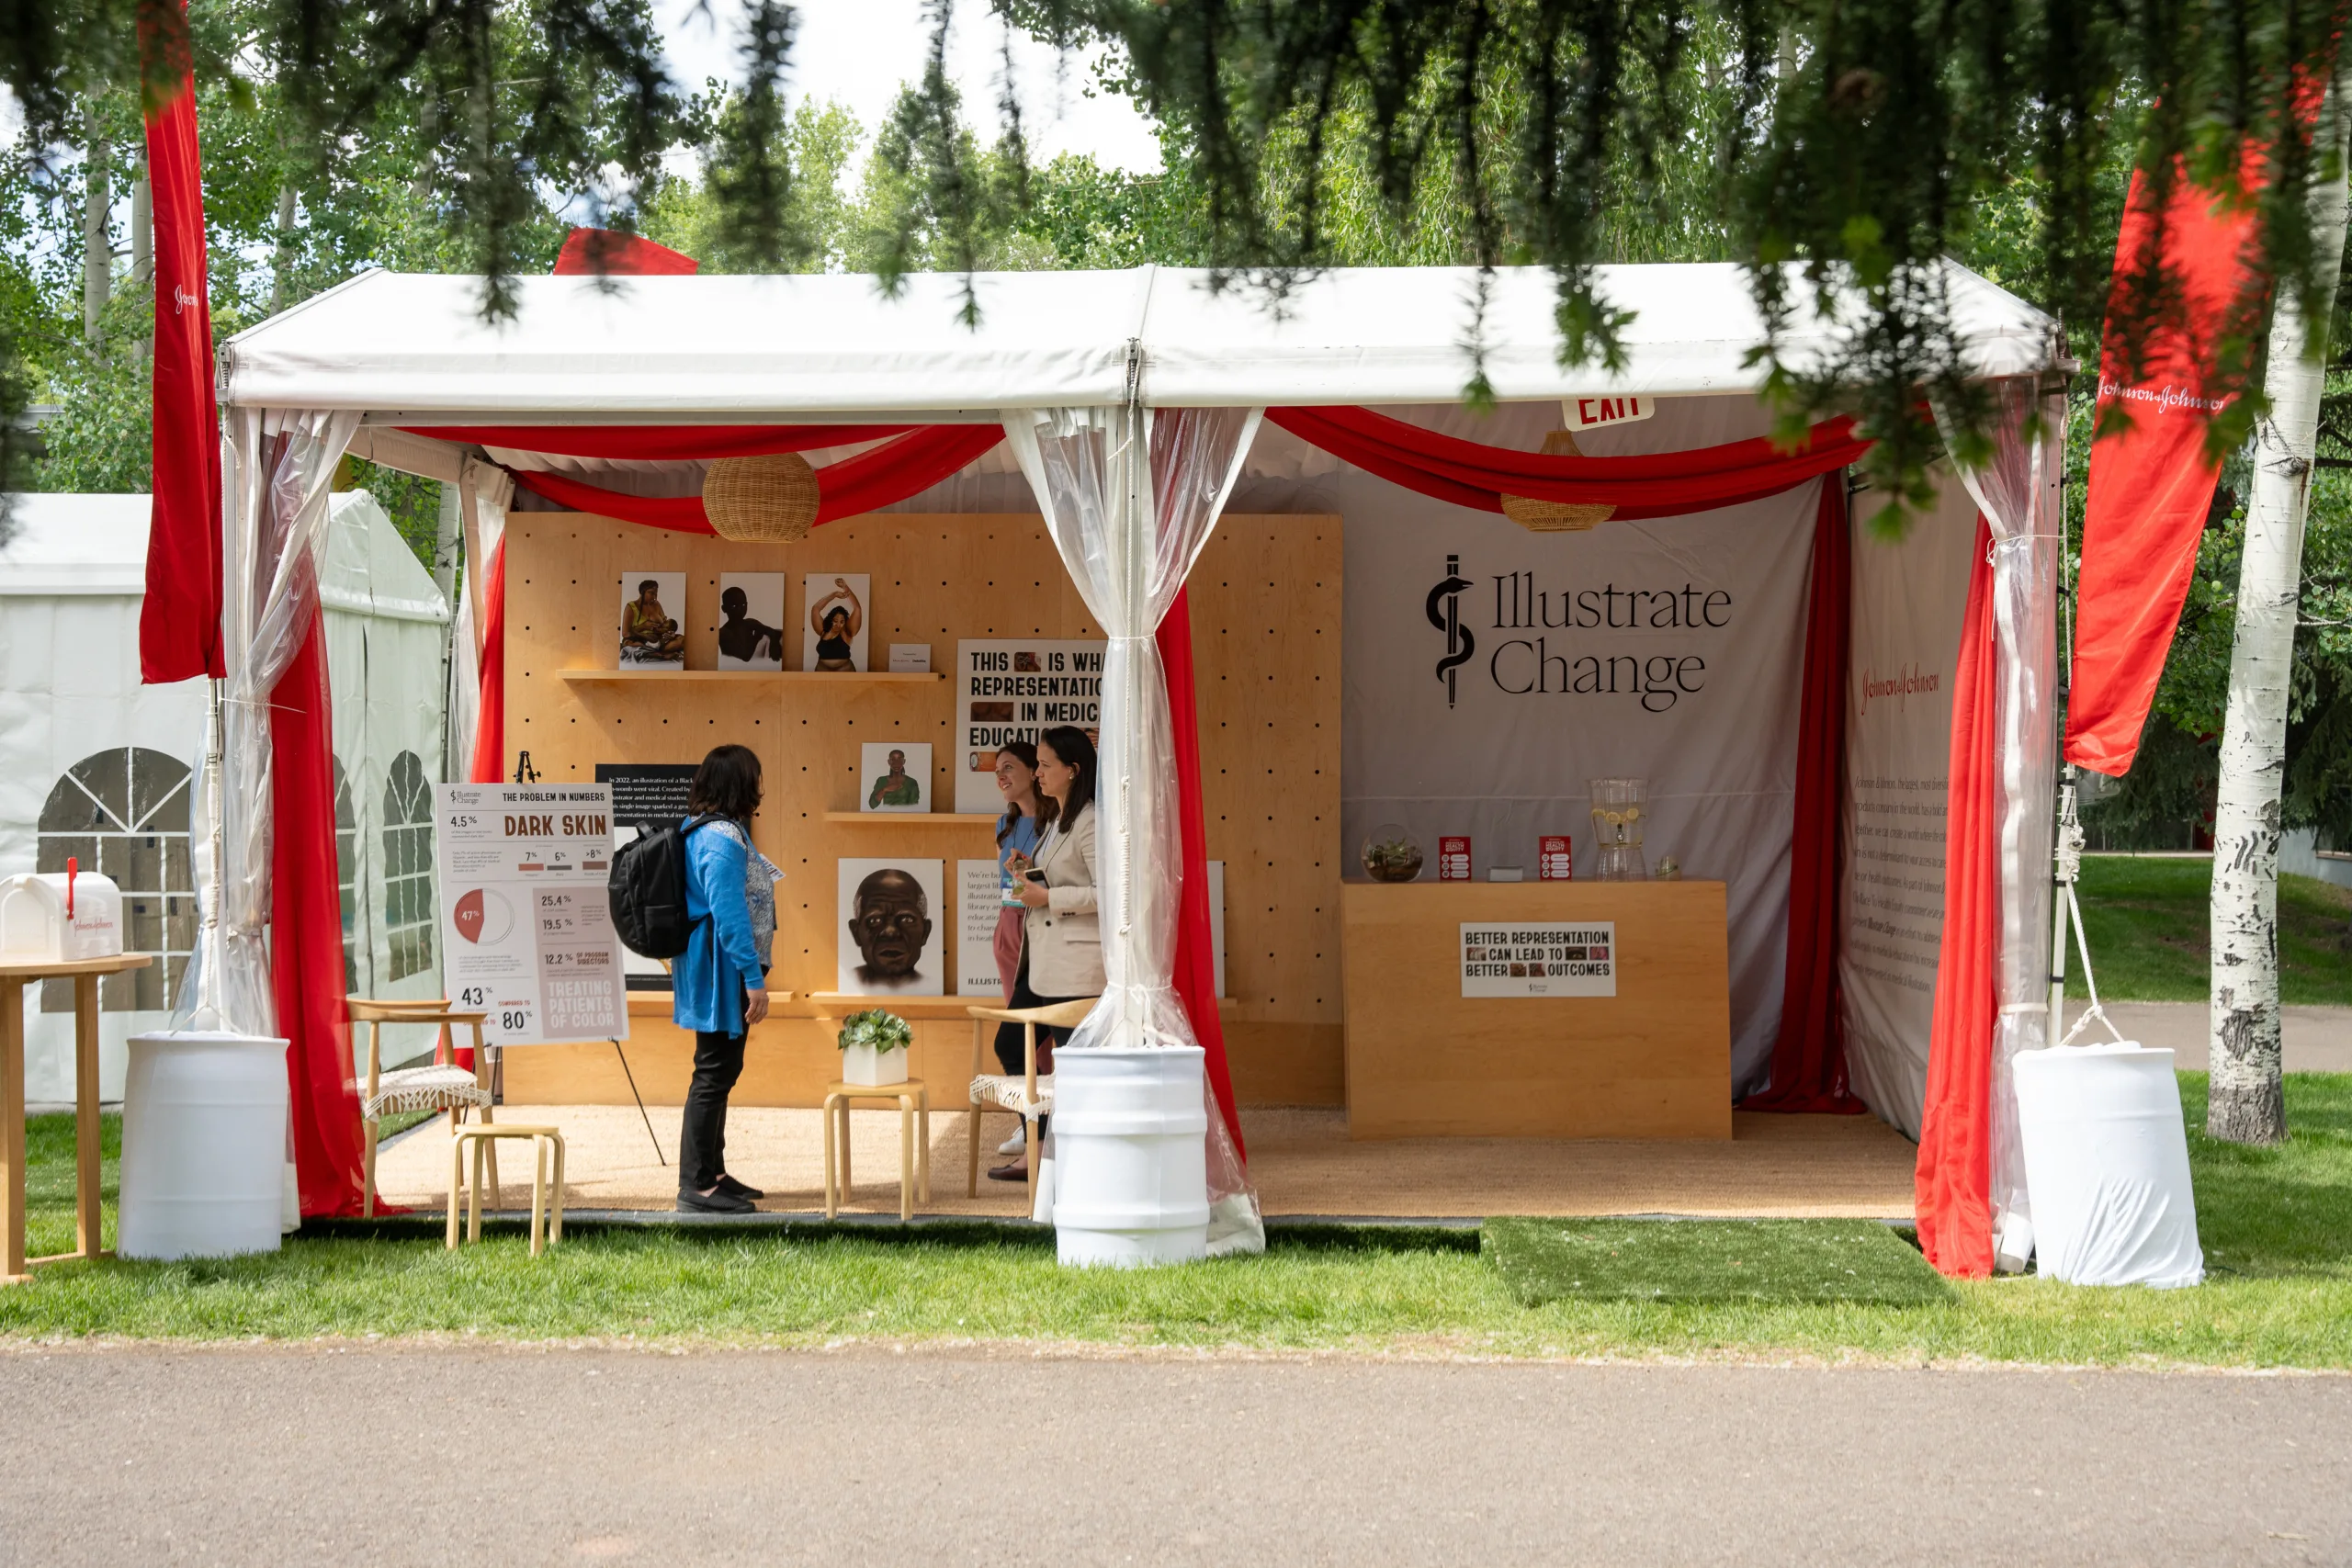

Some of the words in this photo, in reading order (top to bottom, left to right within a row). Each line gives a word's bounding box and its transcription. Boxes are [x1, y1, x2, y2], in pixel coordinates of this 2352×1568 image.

[1490, 570, 1732, 628] Illustrate
[970, 651, 1009, 671] THIS
[1048, 652, 1065, 671] IS
[1072, 652, 1105, 671] WH
[1490, 636, 1706, 713] Change
[1021, 702, 1037, 721] IN
[1045, 702, 1101, 722] MEDIC
[969, 727, 1041, 747] EDUCATI
[503, 793, 517, 802] THE
[519, 793, 557, 802] PROBLEM
[559, 793, 567, 802] IN
[569, 793, 605, 801] NUMBERS
[450, 816, 478, 828] 4.5%
[504, 815, 554, 837] DARK
[561, 814, 607, 836] SKIN
[525, 852, 537, 862] 7%
[554, 852, 567, 862] 6%
[967, 871, 990, 879] We're
[967, 881, 990, 890] largest
[967, 902, 989, 911] library
[461, 910, 481, 921] 47%
[1465, 931, 1508, 945] BETTER
[1511, 931, 1610, 944] REPRESENTATION
[577, 957, 610, 965] DIRECTORS
[1488, 948, 1511, 961] CAN
[1515, 948, 1544, 961] LEAD
[1548, 947, 1563, 960] TO
[1465, 964, 1509, 976] BETTER
[1547, 963, 1610, 976] OUTCOMES
[548, 980, 612, 997] TREATING
[548, 996, 613, 1013] PATIENTS
[550, 1013, 568, 1028] OF
[571, 1012, 615, 1027] COLOR
